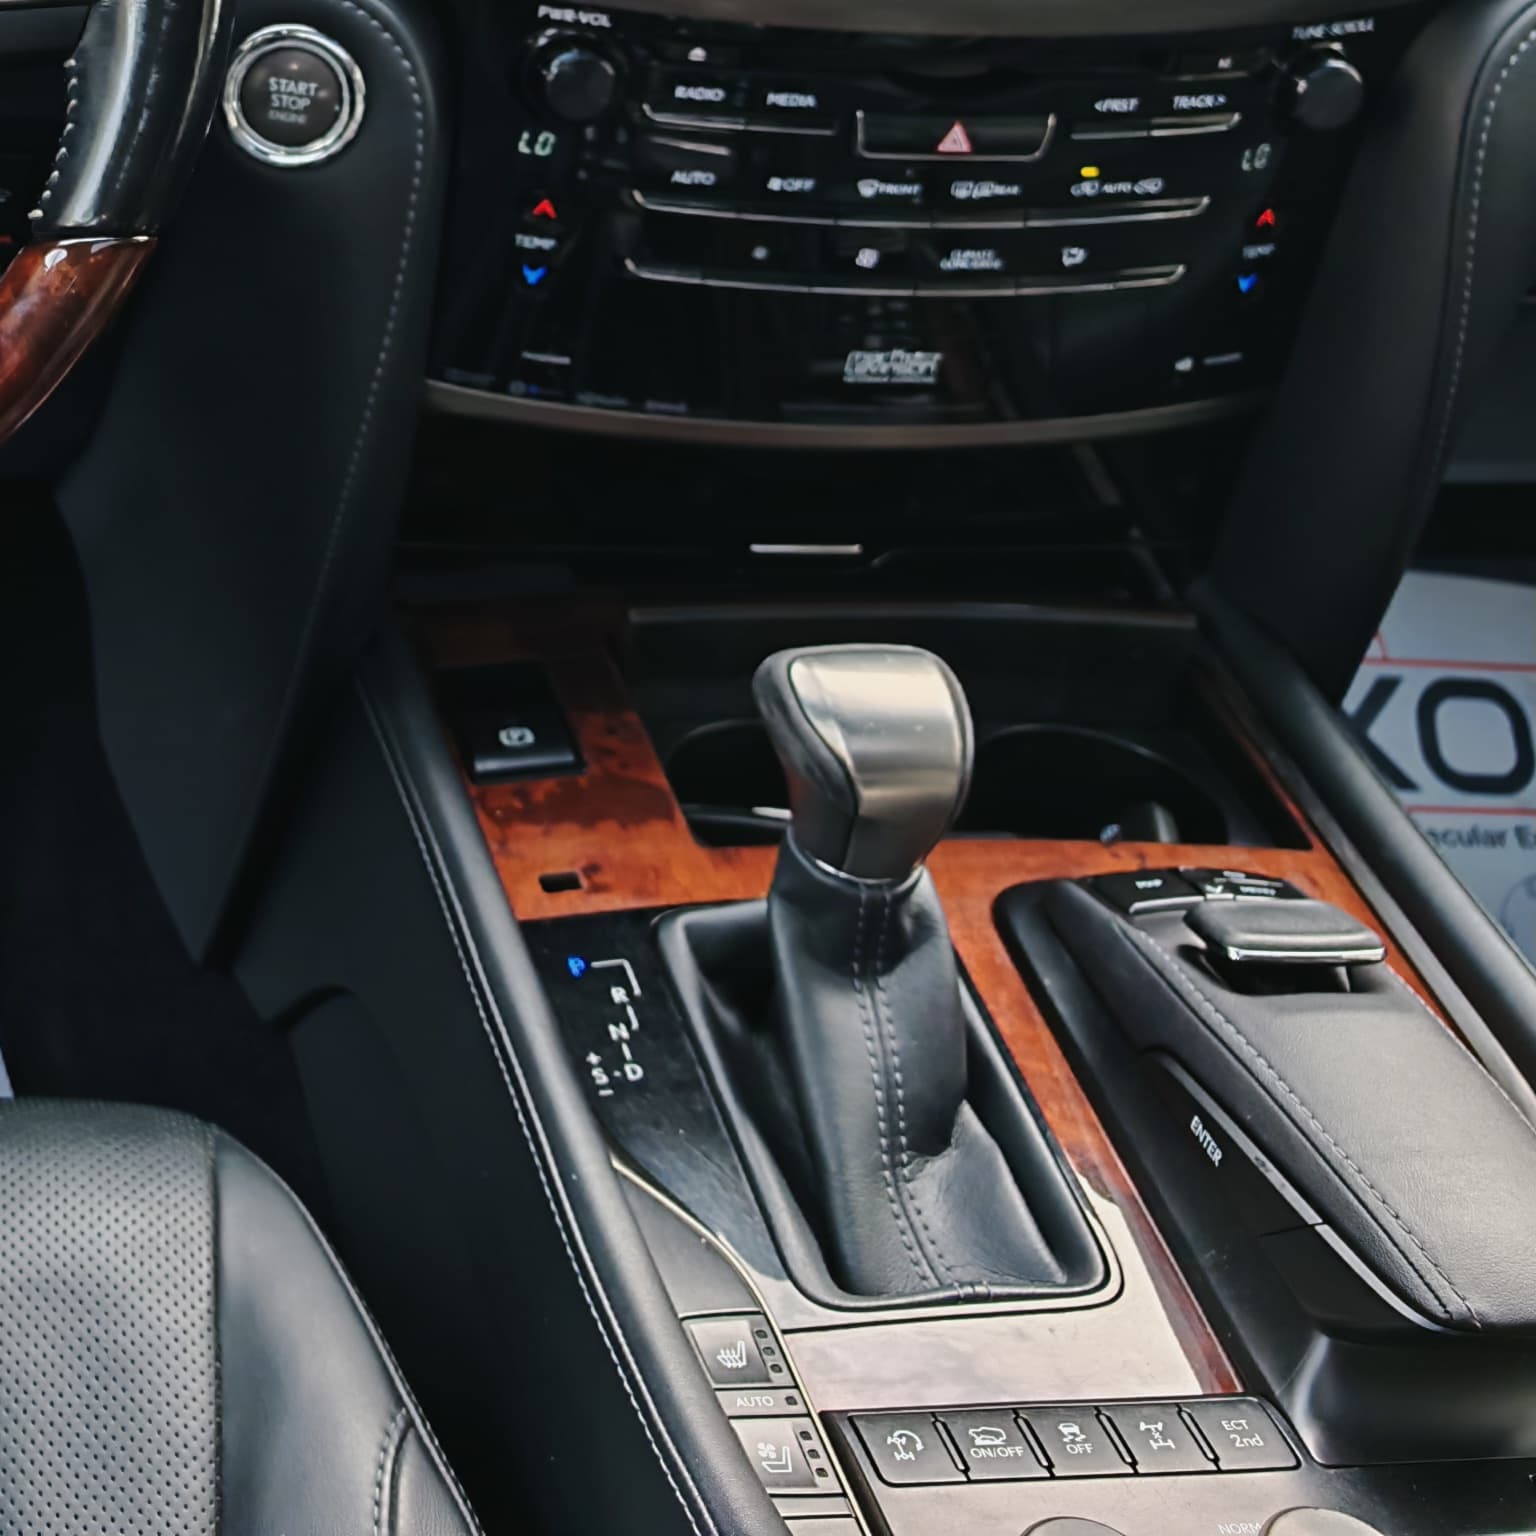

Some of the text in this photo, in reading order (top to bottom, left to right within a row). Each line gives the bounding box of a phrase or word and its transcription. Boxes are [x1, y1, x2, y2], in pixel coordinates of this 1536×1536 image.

[268, 76, 318, 96] START
[674, 85, 726, 103] RADIO
[271, 93, 310, 111] STOP
[766, 92, 817, 109] MEDIA
[671, 170, 716, 186] AUTO
[610, 986, 630, 1005] R
[608, 1021, 630, 1041] N
[591, 1067, 609, 1085] S
[624, 1063, 644, 1082] D
[1190, 1115, 1223, 1167] ENTER
[736, 1395, 774, 1407] AUTO
[1221, 1419, 1249, 1431] ECT
[1066, 1442, 1094, 1454] OFF
[1230, 1433, 1264, 1448] 2nd
[970, 1446, 1024, 1459] ON/OFF
